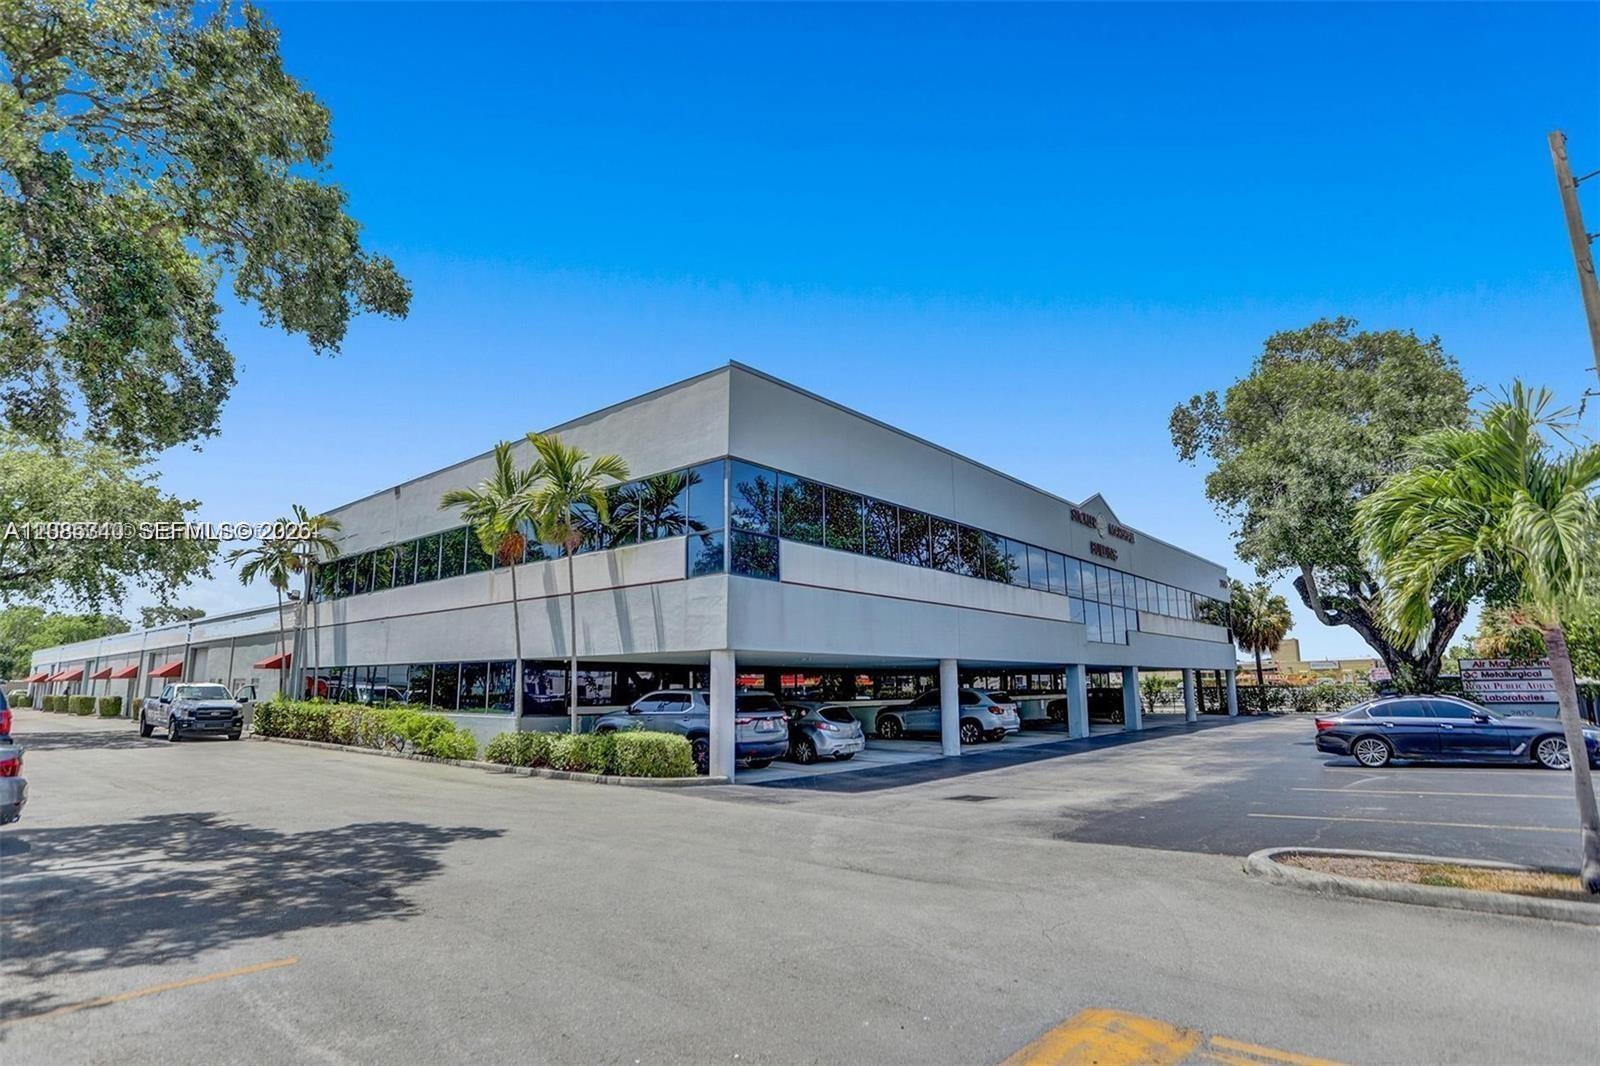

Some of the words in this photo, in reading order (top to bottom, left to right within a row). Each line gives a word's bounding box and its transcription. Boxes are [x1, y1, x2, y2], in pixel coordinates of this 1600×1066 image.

[1472, 660, 1485, 668] Air
[1481, 671, 1542, 680] Metallurgical
[1484, 694, 1545, 702] Laboratories
